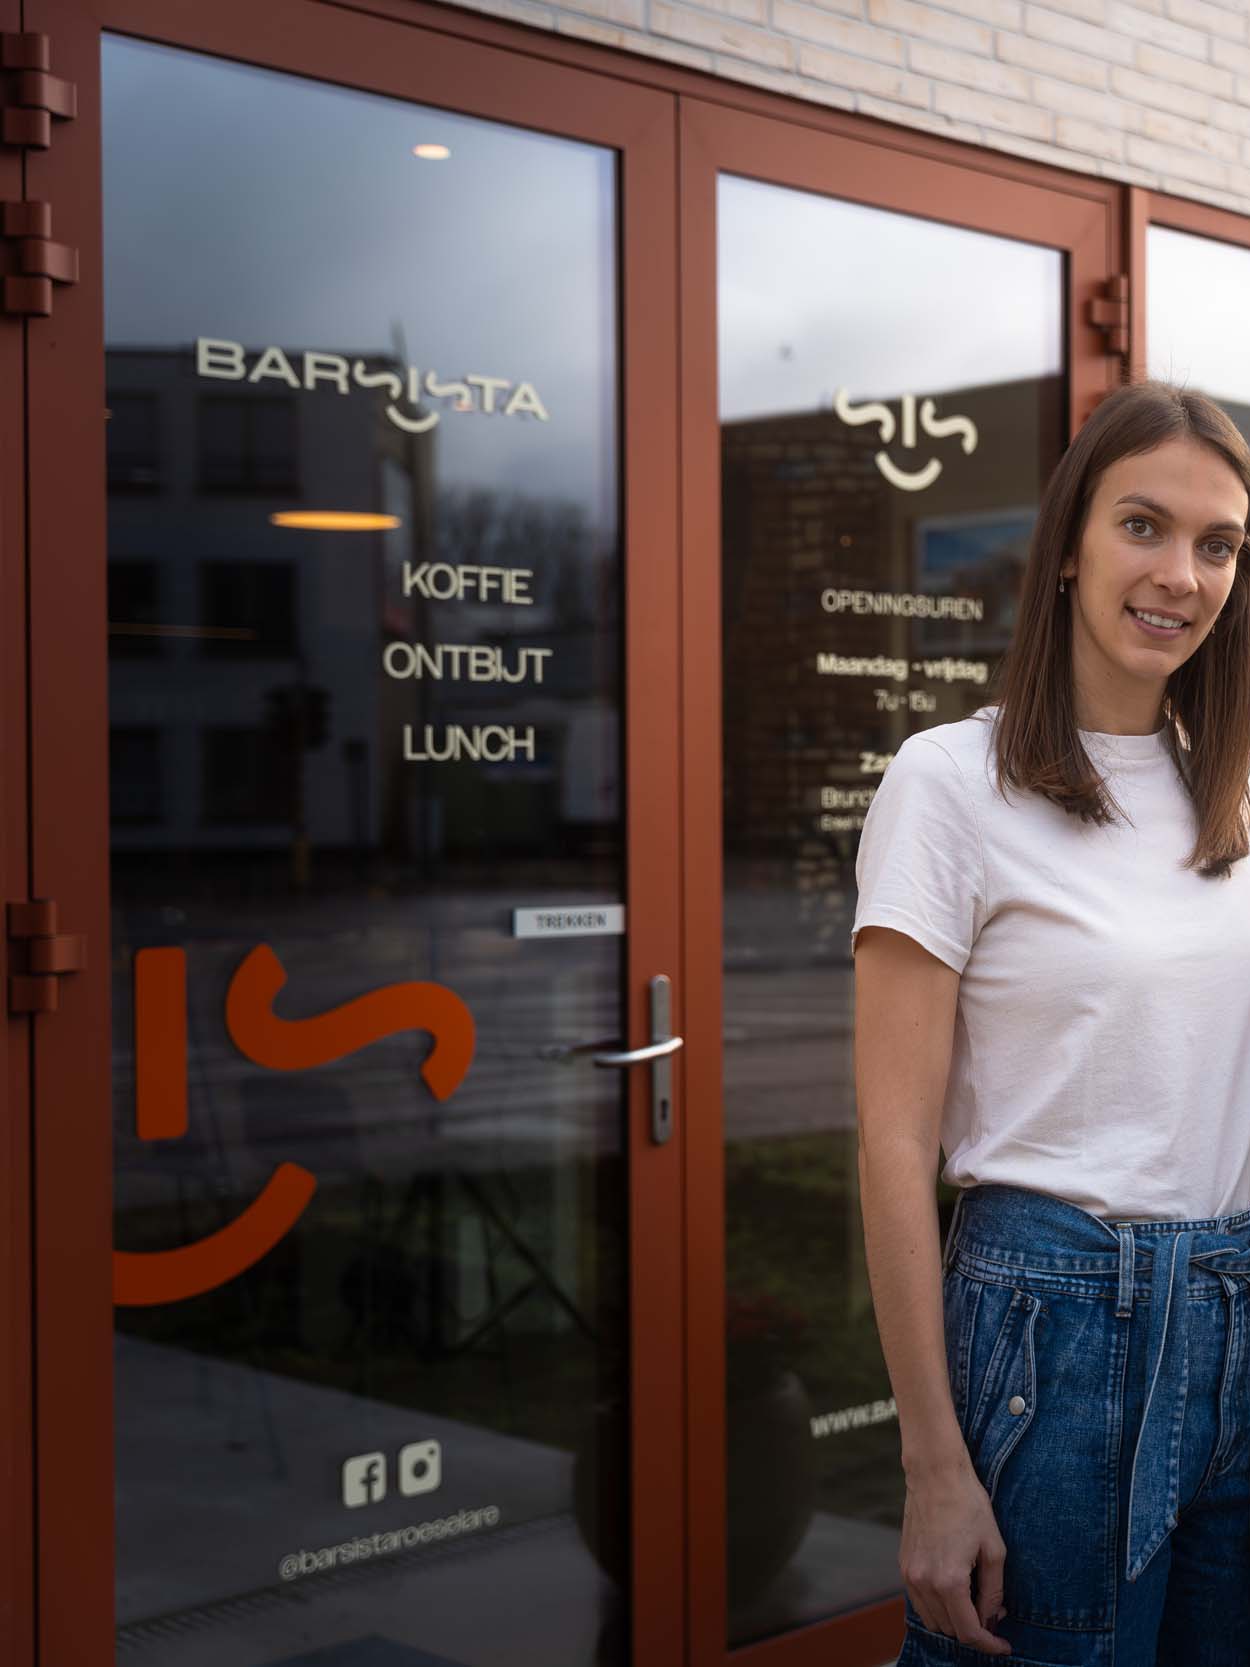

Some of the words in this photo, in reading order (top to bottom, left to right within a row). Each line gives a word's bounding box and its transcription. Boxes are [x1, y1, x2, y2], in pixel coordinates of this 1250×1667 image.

[196, 335, 550, 422] BARSISTA
[402, 560, 533, 604] KOFFIE
[821, 588, 984, 621] OPENINGSUREN
[382, 641, 552, 683] ONTBIJT
[817, 653, 908, 681] Maandag
[923, 657, 988, 683] vrijdag
[402, 724, 535, 762] LUNCH
[536, 911, 608, 931] TREKKEN
[278, 1504, 500, 1581] @barsistaroeselare
